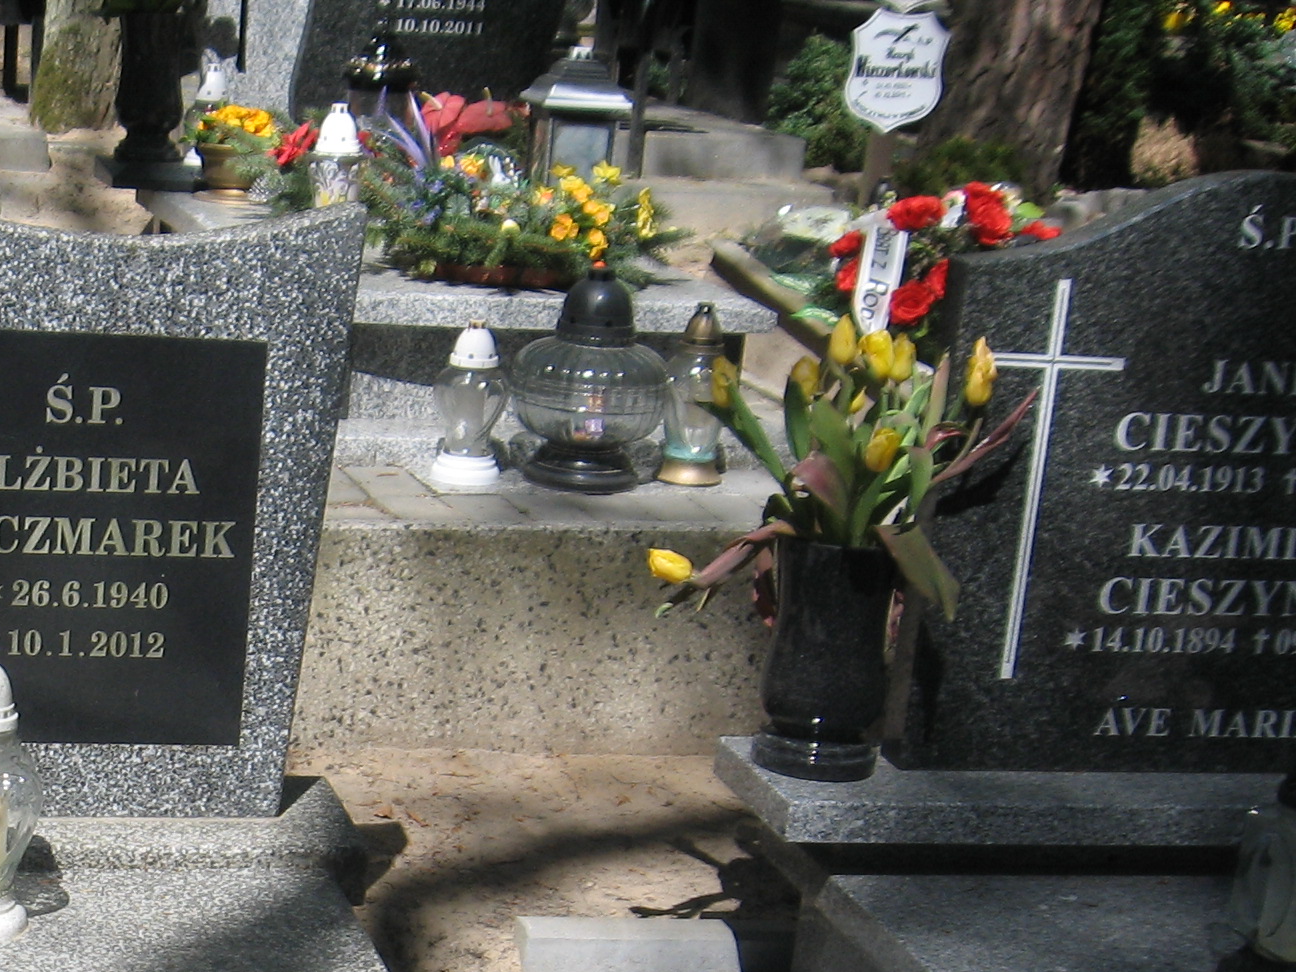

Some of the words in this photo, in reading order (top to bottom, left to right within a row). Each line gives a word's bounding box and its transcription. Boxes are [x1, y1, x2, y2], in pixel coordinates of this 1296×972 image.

[395, 18, 484, 36] 10.10.2011
[1201, 359, 1296, 395] JAN
[44, 372, 125, 425] Ś.P.
[1113, 462, 1266, 494] 22.04.1913
[10, 578, 170, 610] 26.6.1940
[6, 629, 166, 659] 10.1.2012
[1090, 626, 1237, 654] 14.10.1894
[1093, 706, 1172, 737] AVE
